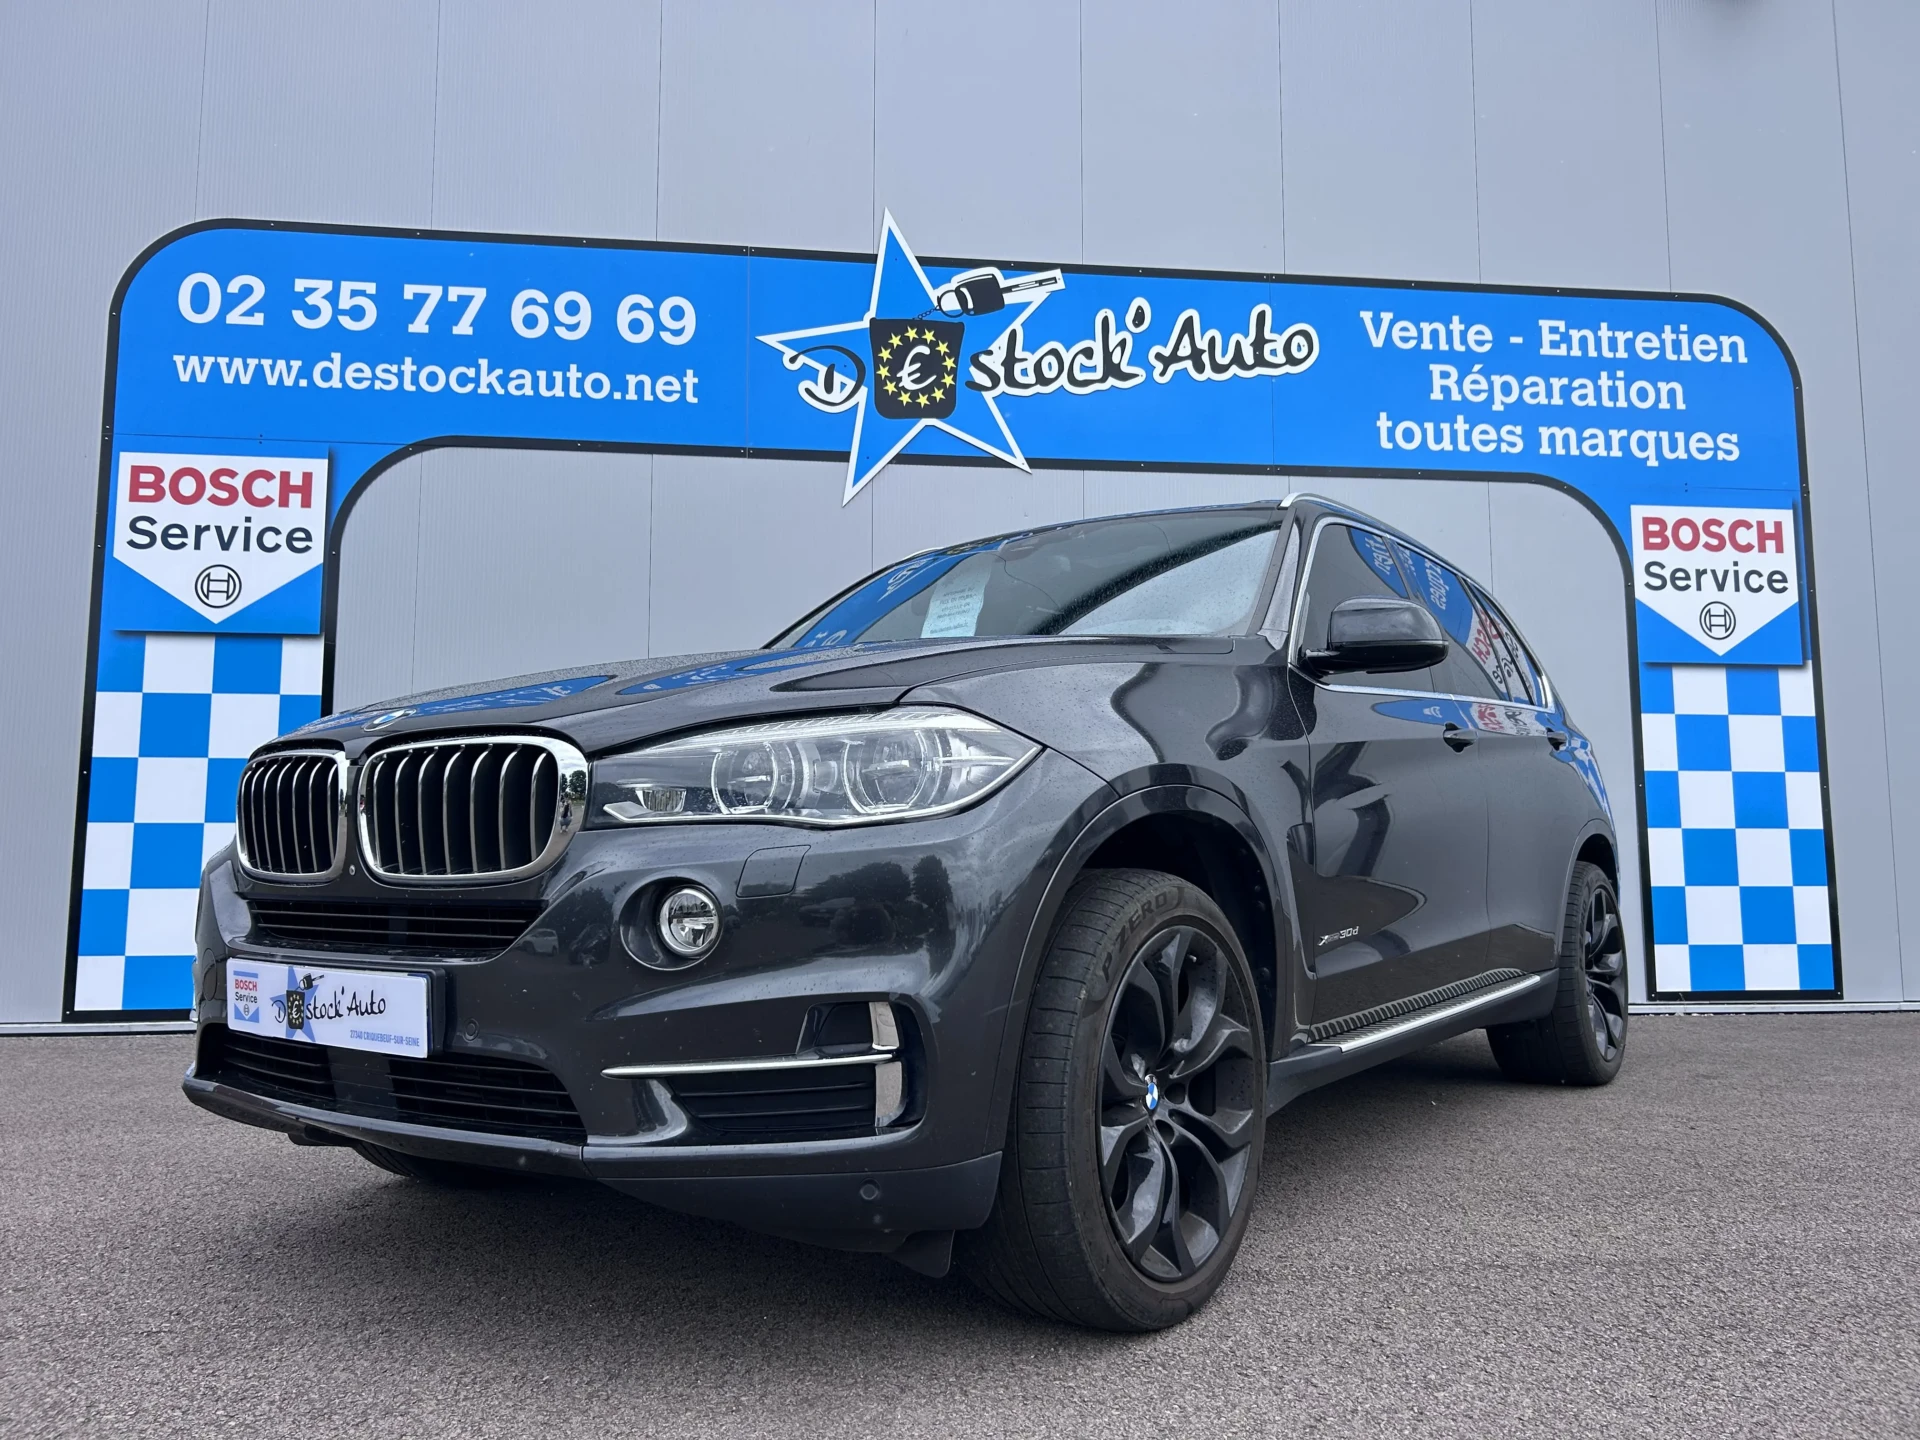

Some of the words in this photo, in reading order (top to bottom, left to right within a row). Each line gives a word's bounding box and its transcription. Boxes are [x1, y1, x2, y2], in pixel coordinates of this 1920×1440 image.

[178, 272, 266, 326] 02
[291, 278, 378, 331] 35
[403, 283, 487, 336] 77
[510, 288, 592, 341] 69
[616, 293, 697, 346] 69
[1359, 310, 1493, 353] Vente
[1538, 318, 1748, 364] Entretien
[172, 352, 699, 404] www.destockauto.net
[1429, 364, 1687, 412] Réparation
[1376, 412, 1524, 454] toutes
[1538, 426, 1740, 467] marques
[128, 465, 313, 509] BOSCH
[126, 515, 313, 554] Service
[1642, 516, 1784, 553] BOSCH
[1643, 561, 1789, 595] Service
[1100, 952, 1113, 984] P
[1115, 895, 1168, 950] ZERO
[234, 979, 258, 992] BOSCH
[234, 992, 258, 1004] Service
[363, 1031, 420, 1047] CRIQUEBEUF-SUR-SEINE
